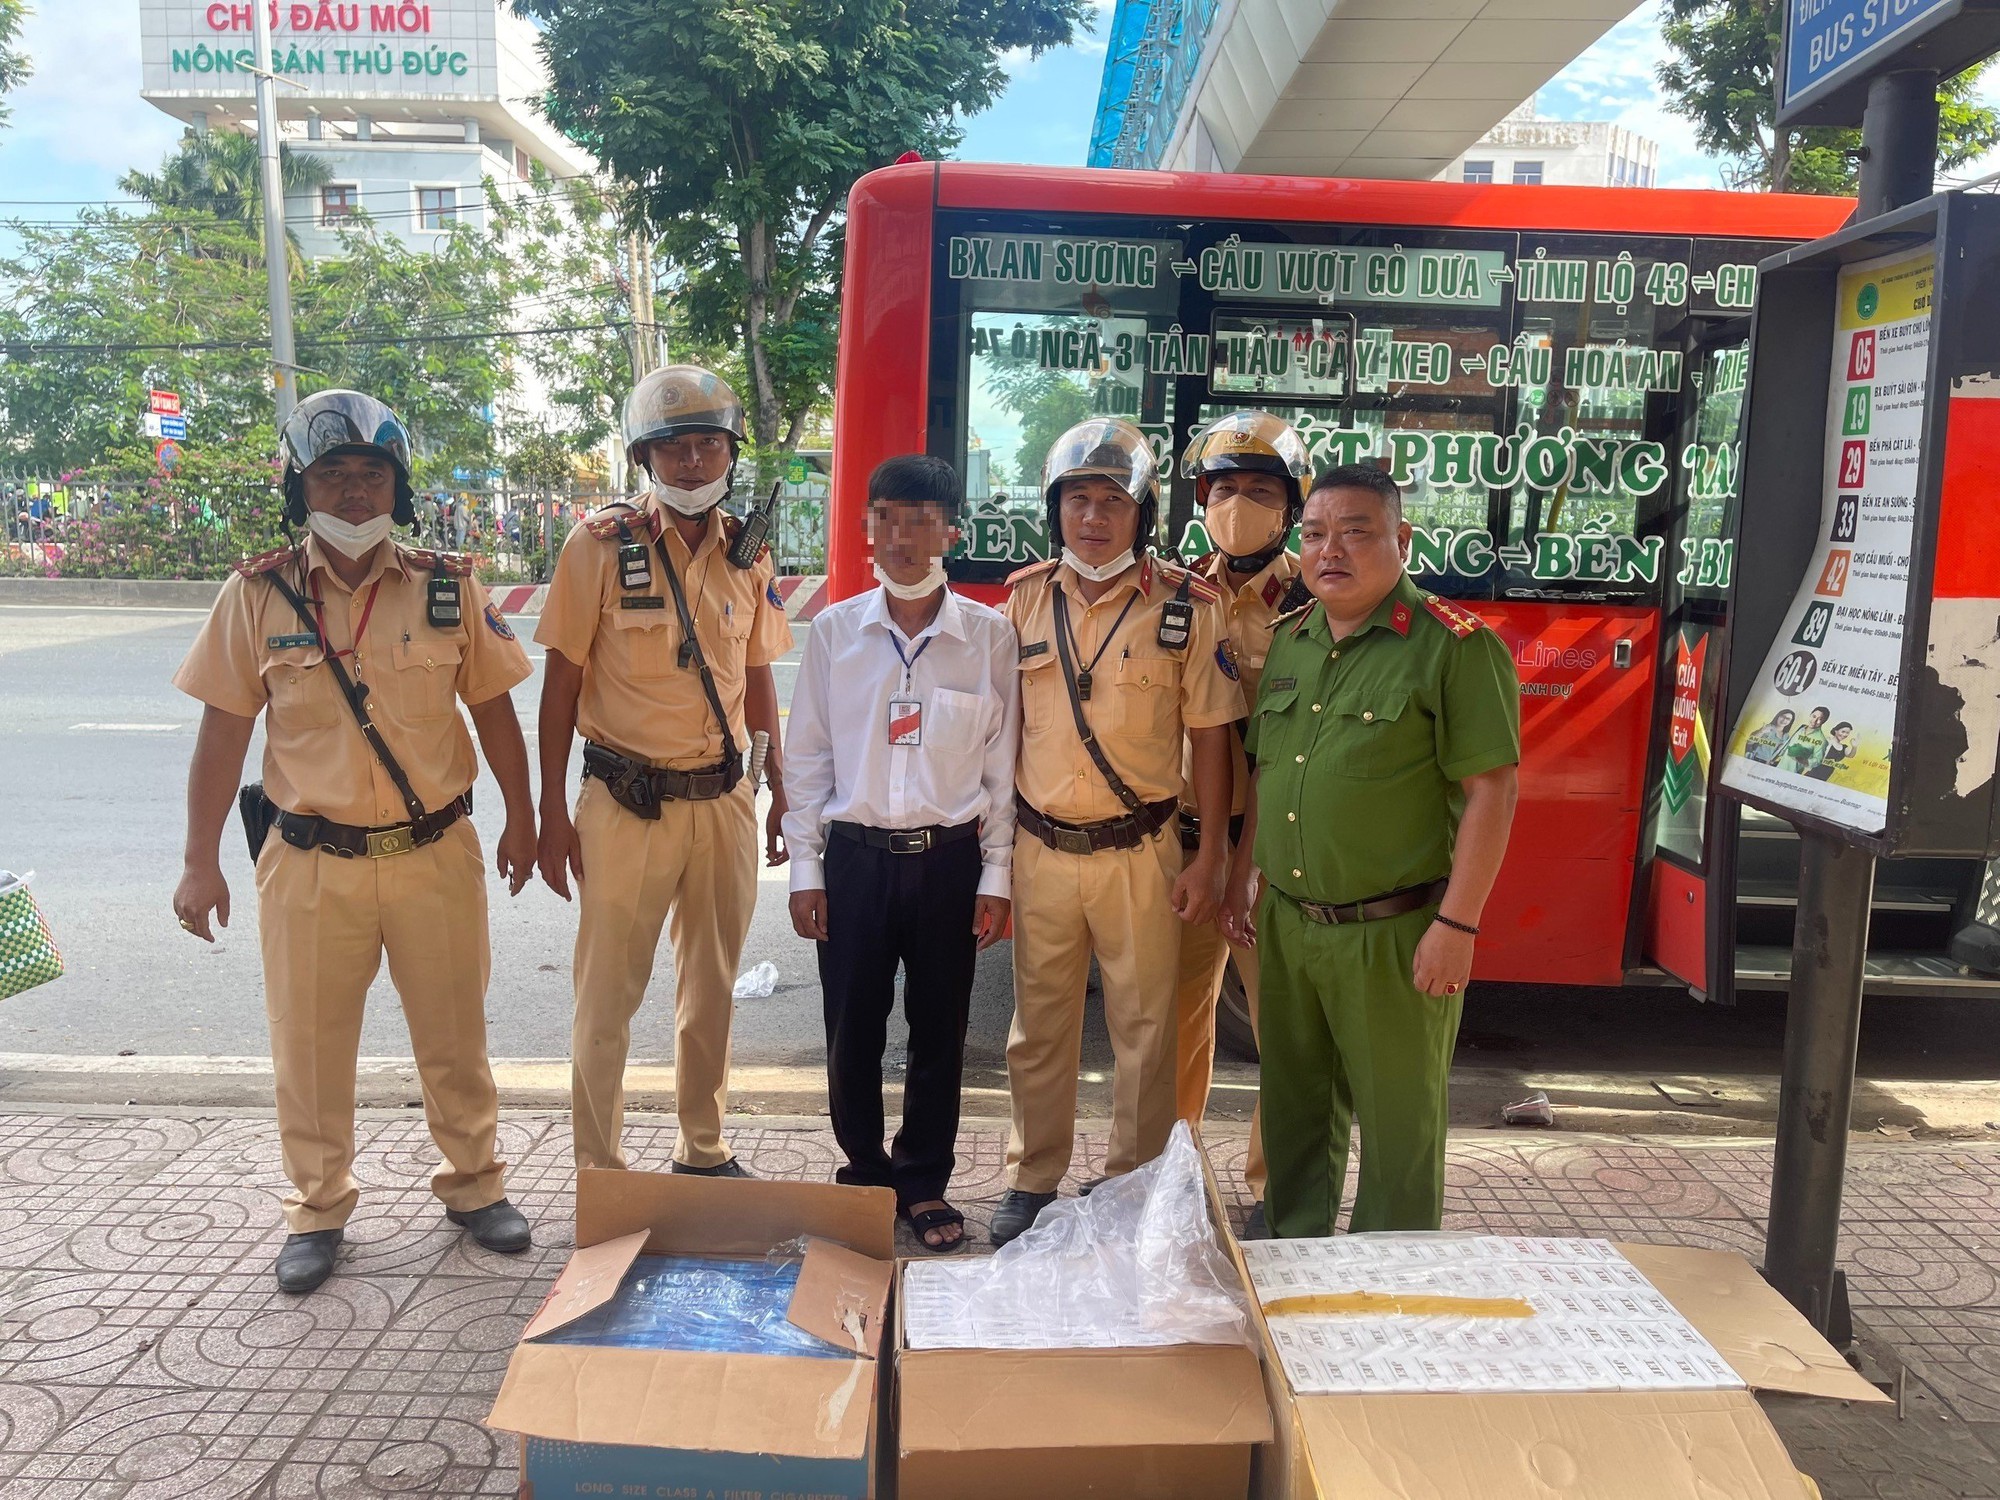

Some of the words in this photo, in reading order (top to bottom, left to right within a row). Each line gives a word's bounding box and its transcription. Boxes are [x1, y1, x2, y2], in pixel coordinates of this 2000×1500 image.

[172, 43, 254, 73] NÔNG
[333, 43, 393, 74] THỦ
[402, 45, 468, 76] ĐỨC
[1808, 12, 1855, 74] BUS
[949, 237, 1042, 281] BX.AN
[1054, 241, 1157, 288] SƯƠNG
[1200, 233, 1265, 292] CẦU
[1276, 248, 1358, 305] VƯỢT
[1366, 243, 1408, 298] GÒ
[1418, 253, 1481, 298] DƯA
[1516, 247, 1588, 303] TỈNH
[1594, 250, 1636, 316] LỘ
[1644, 262, 1688, 306] 43
[1714, 263, 1758, 308] CH
[1879, 325, 1890, 341] BẾN
[1891, 326, 1898, 339] XE
[1040, 322, 1101, 372] NGÃ
[1114, 332, 1135, 372] 3
[1148, 324, 1210, 376] TÂN
[1226, 325, 1290, 389] HẬU
[1387, 340, 1452, 385] KEO
[1489, 331, 1553, 387] CẦU
[1564, 338, 1628, 391] HOÁ
[1634, 350, 1684, 393] AN
[1855, 336, 1872, 376] 05
[1883, 382, 1897, 396] BUÝT
[1850, 392, 1867, 430] 19
[1389, 422, 1668, 497] PHƯƠNG
[1869, 437, 1881, 452] BẾN
[1844, 446, 1862, 484] 29
[1862, 493, 1873, 508] BẾN
[1873, 496, 1881, 508] XE
[1881, 496, 1890, 508] AN
[1838, 501, 1856, 538] 33
[1532, 512, 1665, 583] BẾN
[1853, 552, 1865, 566] CHỢ
[1866, 549, 1877, 565] CẦU
[1878, 551, 1893, 566] MUỐI
[1826, 556, 1846, 591] 42
[1802, 607, 1828, 643] 89
[1836, 605, 1847, 619] ĐẠI
[1849, 608, 1861, 620] HỌC
[1862, 607, 1879, 621] NÔNG
[1879, 609, 1893, 624] LÂM
[1516, 640, 1597, 669] Lines
[1821, 658, 1837, 673] BẾN
[1837, 664, 1847, 675] XE
[1848, 664, 1867, 680] MIỀN
[1869, 669, 1884, 683] TÂY
[1676, 657, 1697, 689] CỬA
[1775, 654, 1815, 693] 60-1
[1551, 683, 1573, 699] DỰ
[1673, 725, 1688, 748] Exit
[575, 1481, 614, 1494] LONG
[622, 1484, 647, 1496] SIZE
[656, 1486, 697, 1498] CLASS
[706, 1489, 715, 1500] A
